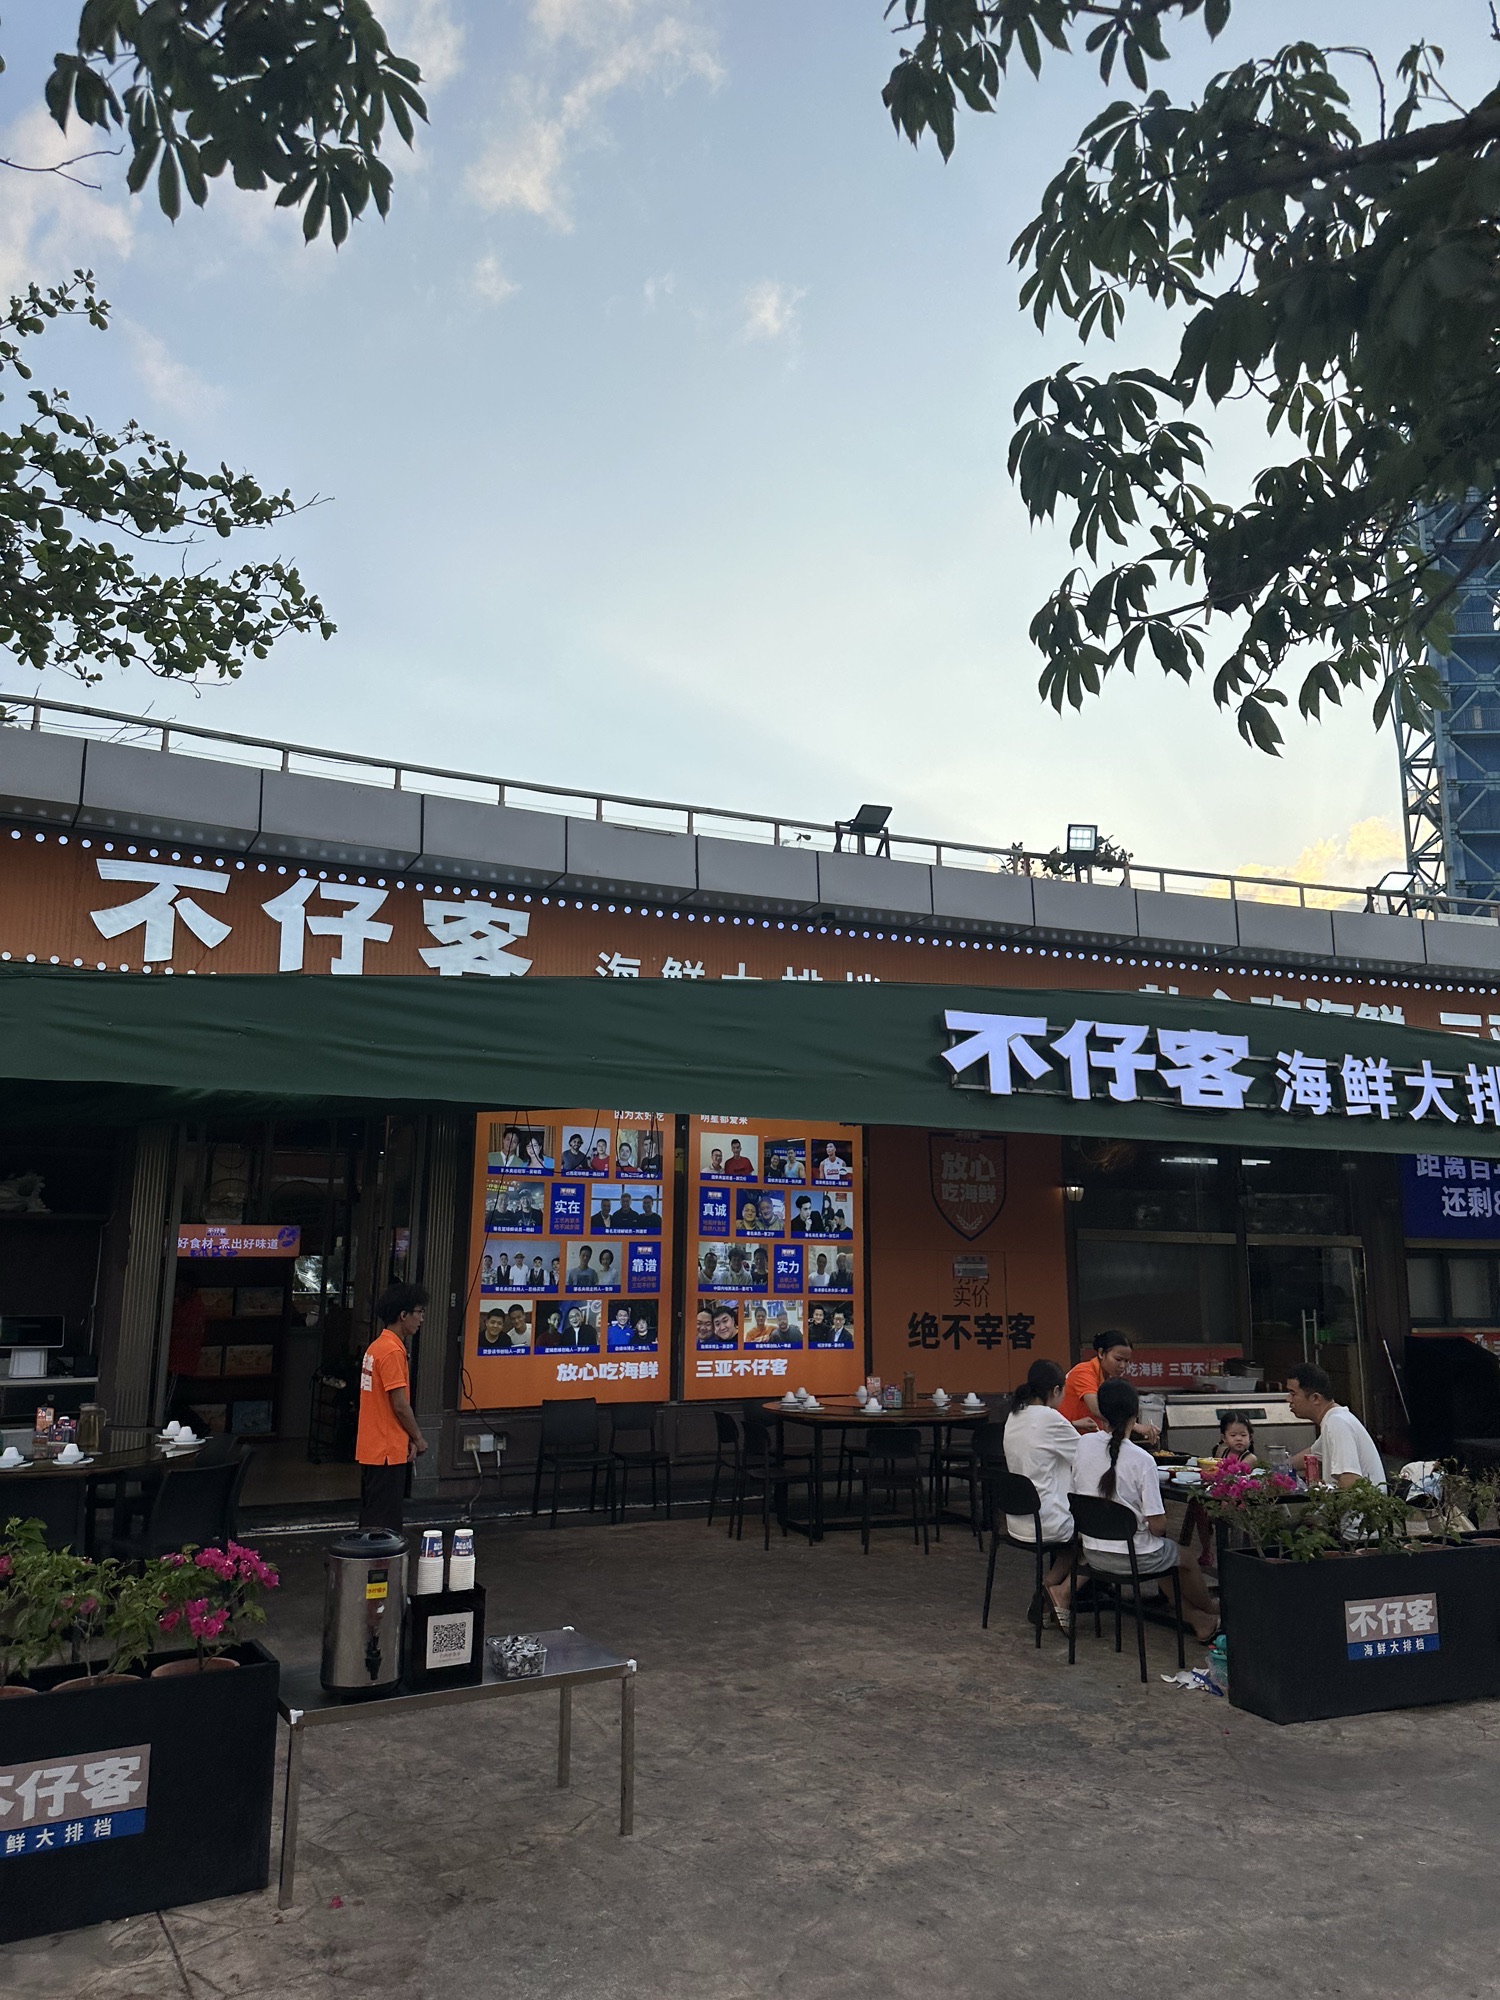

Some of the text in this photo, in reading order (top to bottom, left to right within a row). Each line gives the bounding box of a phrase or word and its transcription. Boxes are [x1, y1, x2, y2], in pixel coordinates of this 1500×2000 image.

[90, 857, 533, 977] 不仔客
[941, 1009, 1256, 1109] 不仔客
[1275, 1049, 1500, 1126] 海鲜大排
[941, 1152, 996, 1182] 放心
[1416, 1154, 1500, 1181] 距离百
[941, 1184, 997, 1204] 吃海鲜
[554, 1201, 580, 1214] 实在
[702, 1204, 727, 1217] 真诚
[177, 1238, 279, 1249] 好食材 烹出好味道
[631, 1259, 657, 1272] 靠谱
[777, 1261, 800, 1274] 实力
[953, 1285, 990, 1308] 实价
[908, 1312, 1036, 1350] 绝不宰客
[556, 1361, 659, 1382] 放心吃海鲜
[695, 1359, 789, 1378] 三亚不仔客
[1348, 1599, 1436, 1637] 不仔客
[1364, 1638, 1425, 1657] 海鲜大排档
[0, 1756, 142, 1821] 仔客
[6, 1817, 112, 1854] 鲜大排档
